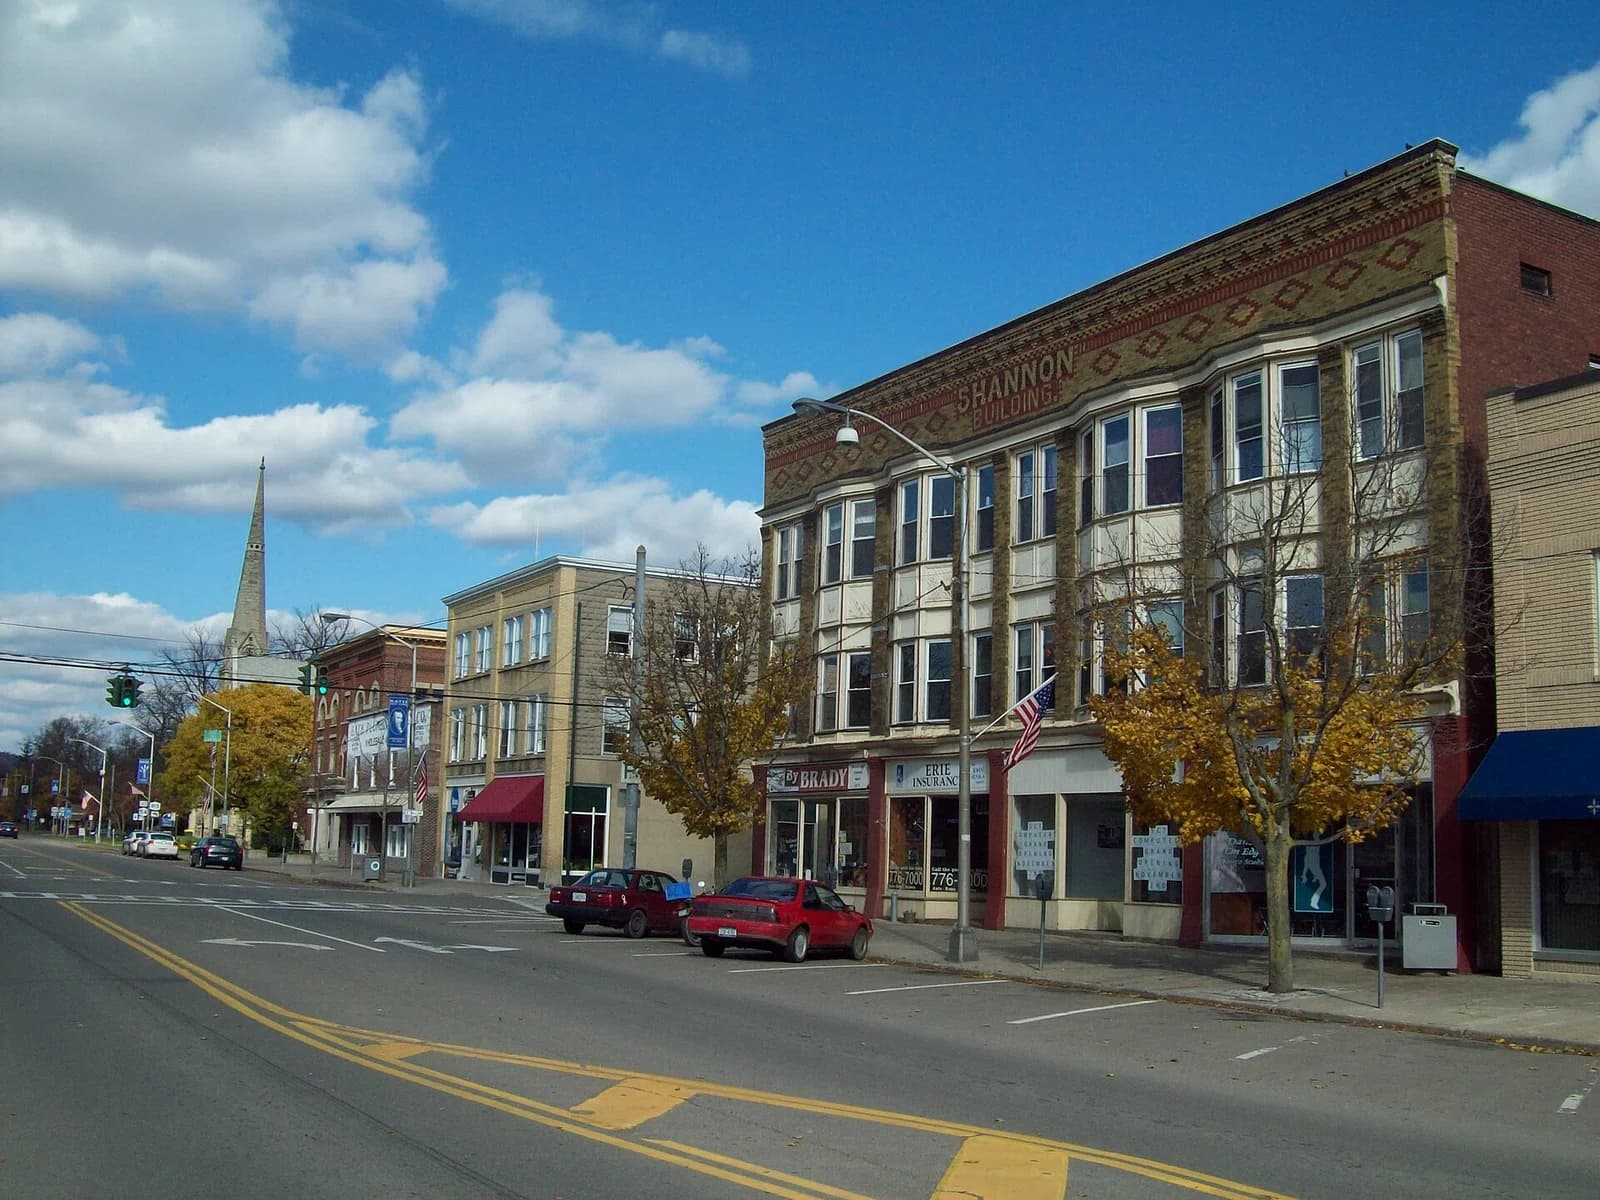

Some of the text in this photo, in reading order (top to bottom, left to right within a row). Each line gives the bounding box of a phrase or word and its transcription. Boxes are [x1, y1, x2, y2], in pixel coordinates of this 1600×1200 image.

[957, 350, 1074, 413] SHANNON
[800, 768, 848, 788] BRADY
[925, 763, 951, 777] ERIE
[912, 775, 960, 788] INSURANC
[888, 870, 923, 886] 776-7000
